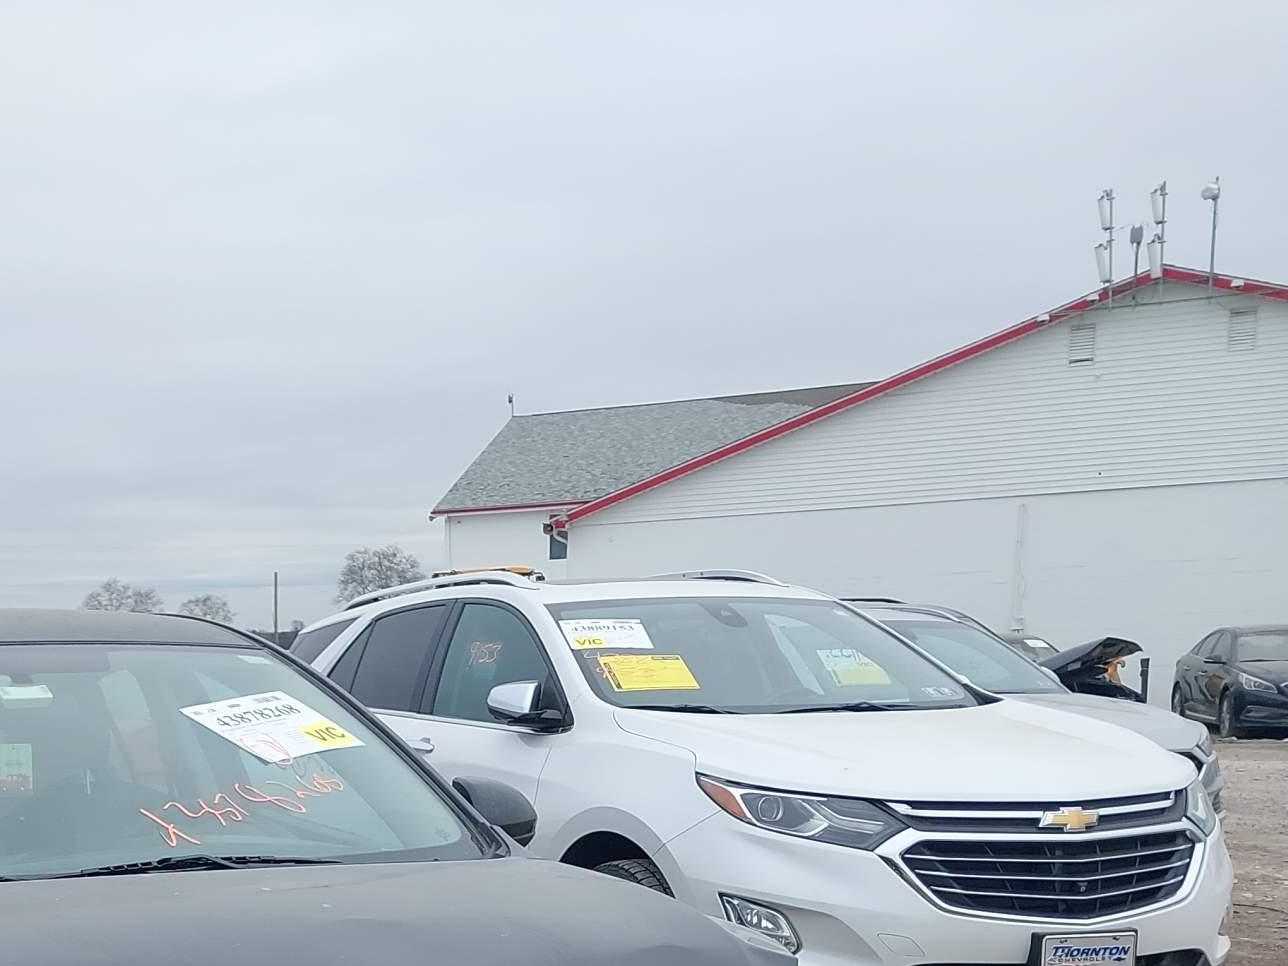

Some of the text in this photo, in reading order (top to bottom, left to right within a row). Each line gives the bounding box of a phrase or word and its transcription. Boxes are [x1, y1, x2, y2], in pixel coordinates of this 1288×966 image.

[576, 637, 603, 646] VIC
[216, 703, 301, 728] 43878268
[305, 726, 346, 742] VIC
[1052, 946, 1131, 958] THORNTON
